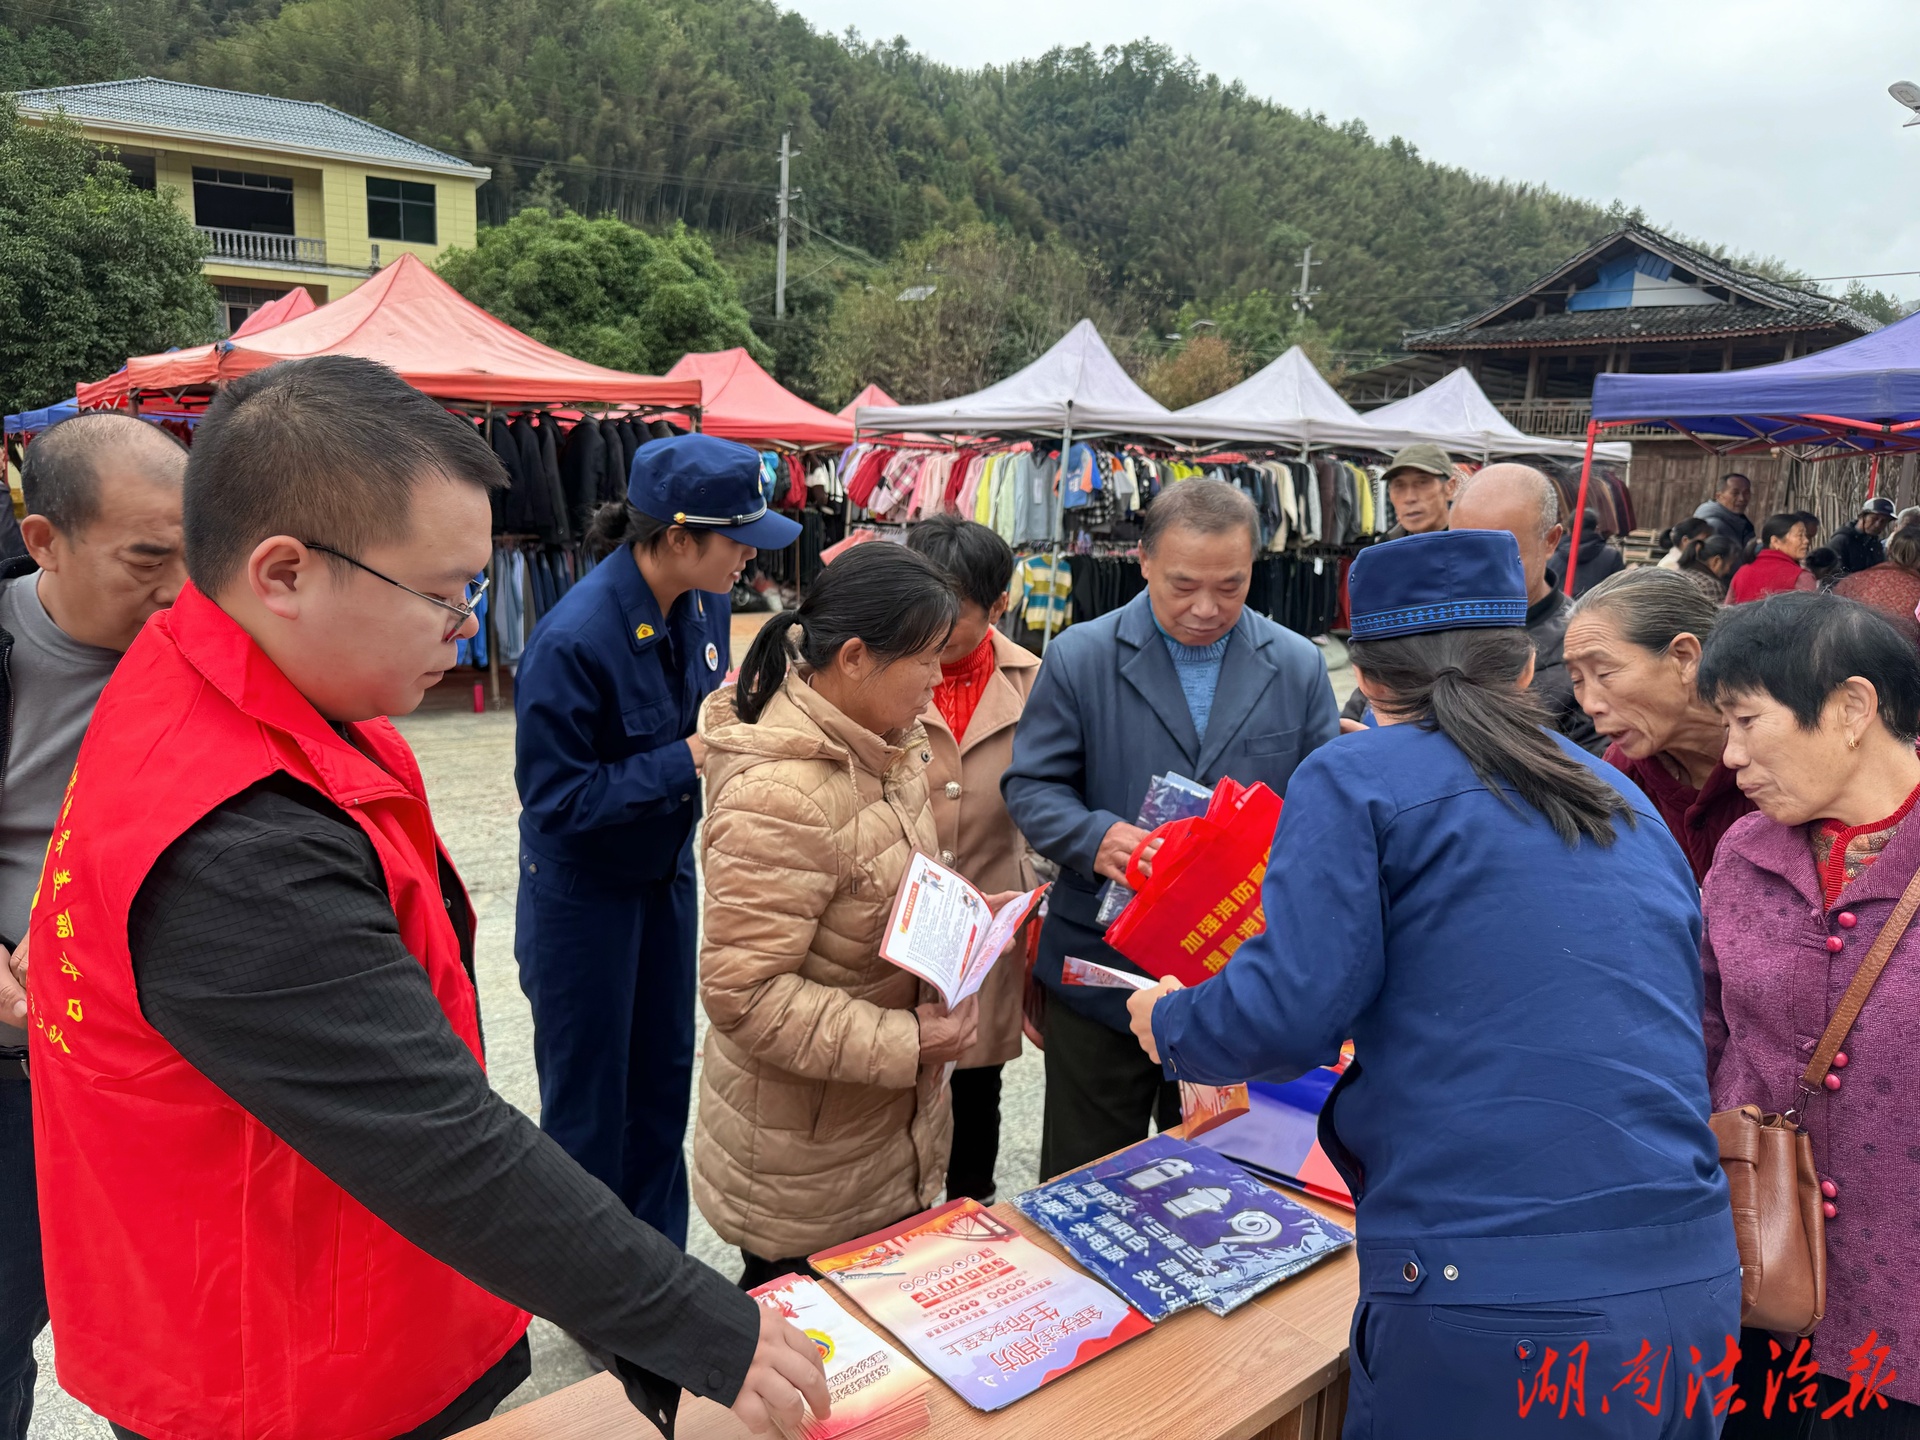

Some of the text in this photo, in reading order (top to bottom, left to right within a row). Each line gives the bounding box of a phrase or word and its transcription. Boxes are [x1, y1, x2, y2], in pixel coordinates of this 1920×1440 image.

[940, 1300, 1061, 1357] 生命安全至上
[989, 1305, 1104, 1373] 全民关注消防
